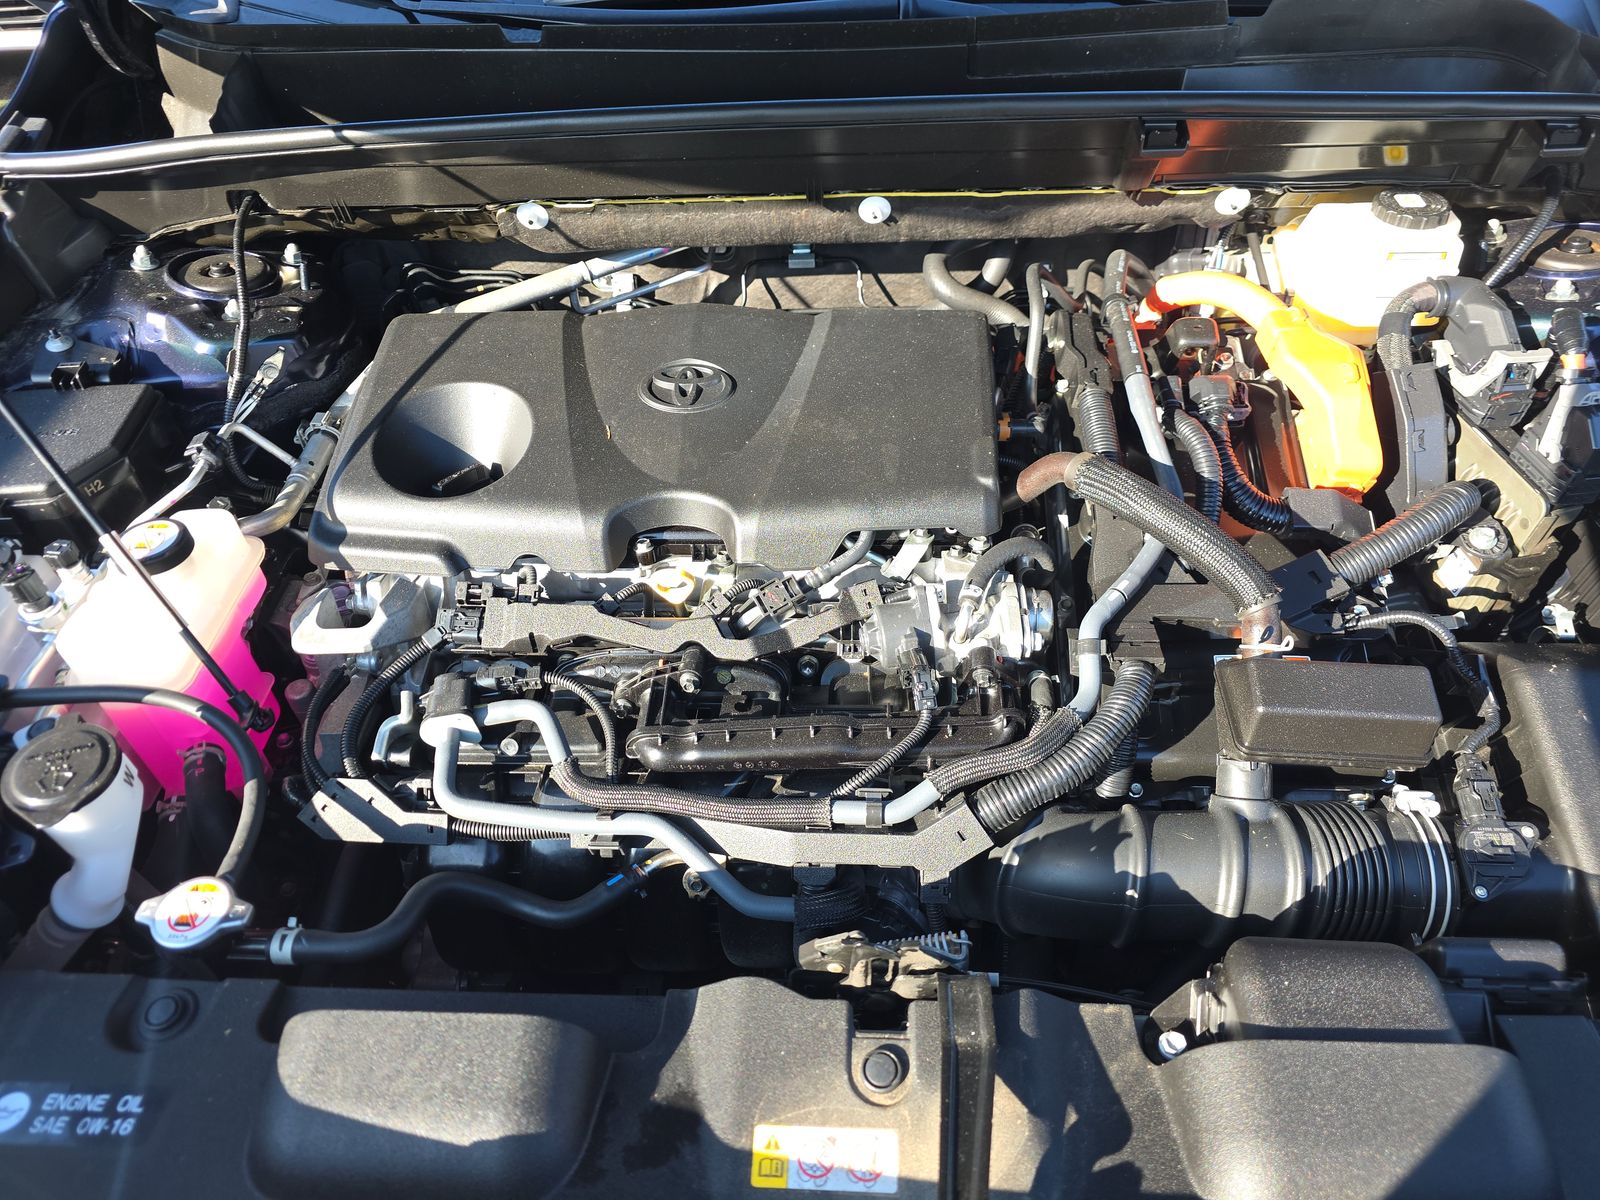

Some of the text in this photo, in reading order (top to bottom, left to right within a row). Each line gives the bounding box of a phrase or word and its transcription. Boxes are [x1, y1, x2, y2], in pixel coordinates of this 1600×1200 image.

[84, 479, 105, 497] H2
[41, 1092, 144, 1113] ENGINE OIL
[29, 1115, 136, 1136] SAE 0W-16
